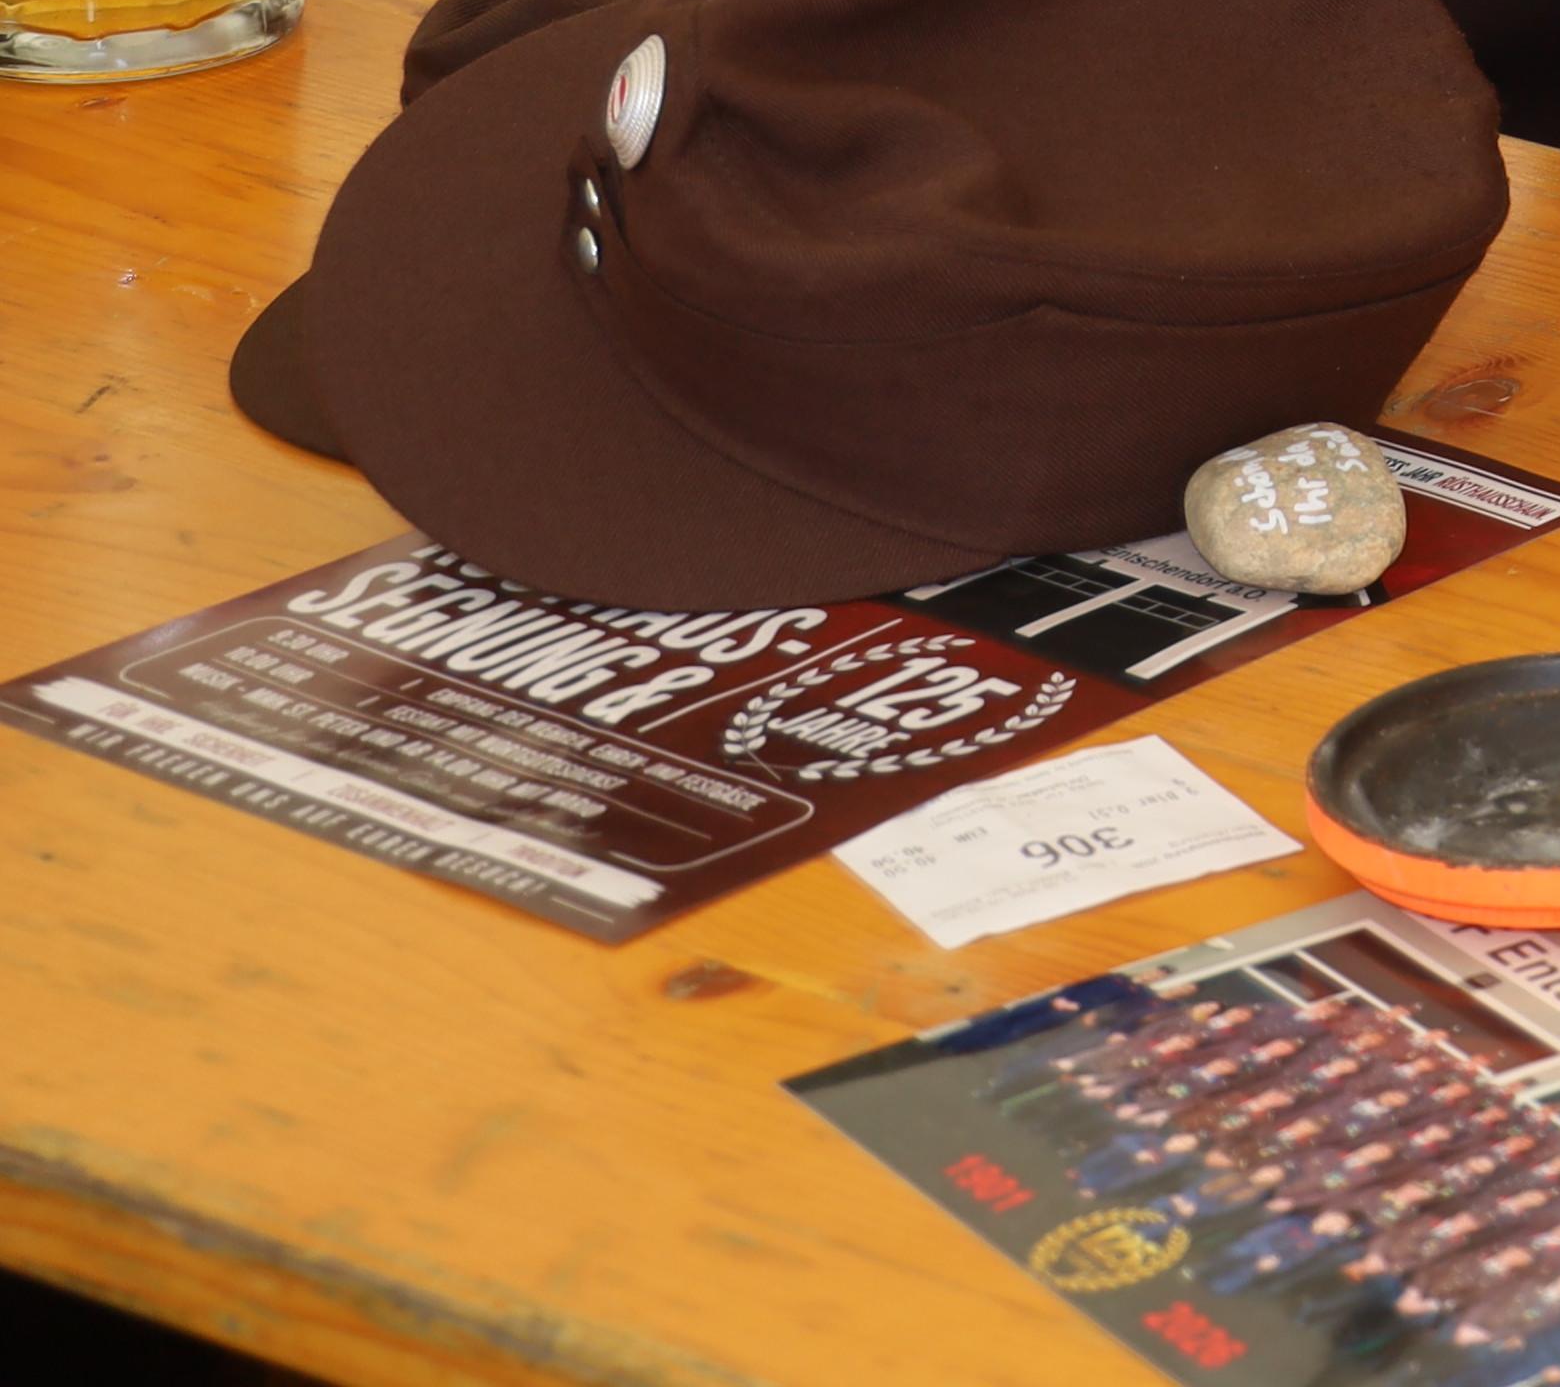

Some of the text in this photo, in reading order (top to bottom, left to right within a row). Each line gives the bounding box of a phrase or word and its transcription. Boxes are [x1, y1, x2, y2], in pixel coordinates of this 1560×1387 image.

[1295, 477, 1332, 524] Ihr
[291, 561, 654, 700] SEGNUNG
[583, 665, 714, 724] &
[838, 657, 1018, 730] 125
[767, 708, 909, 764] JAHRE
[1020, 826, 1134, 867] 306
